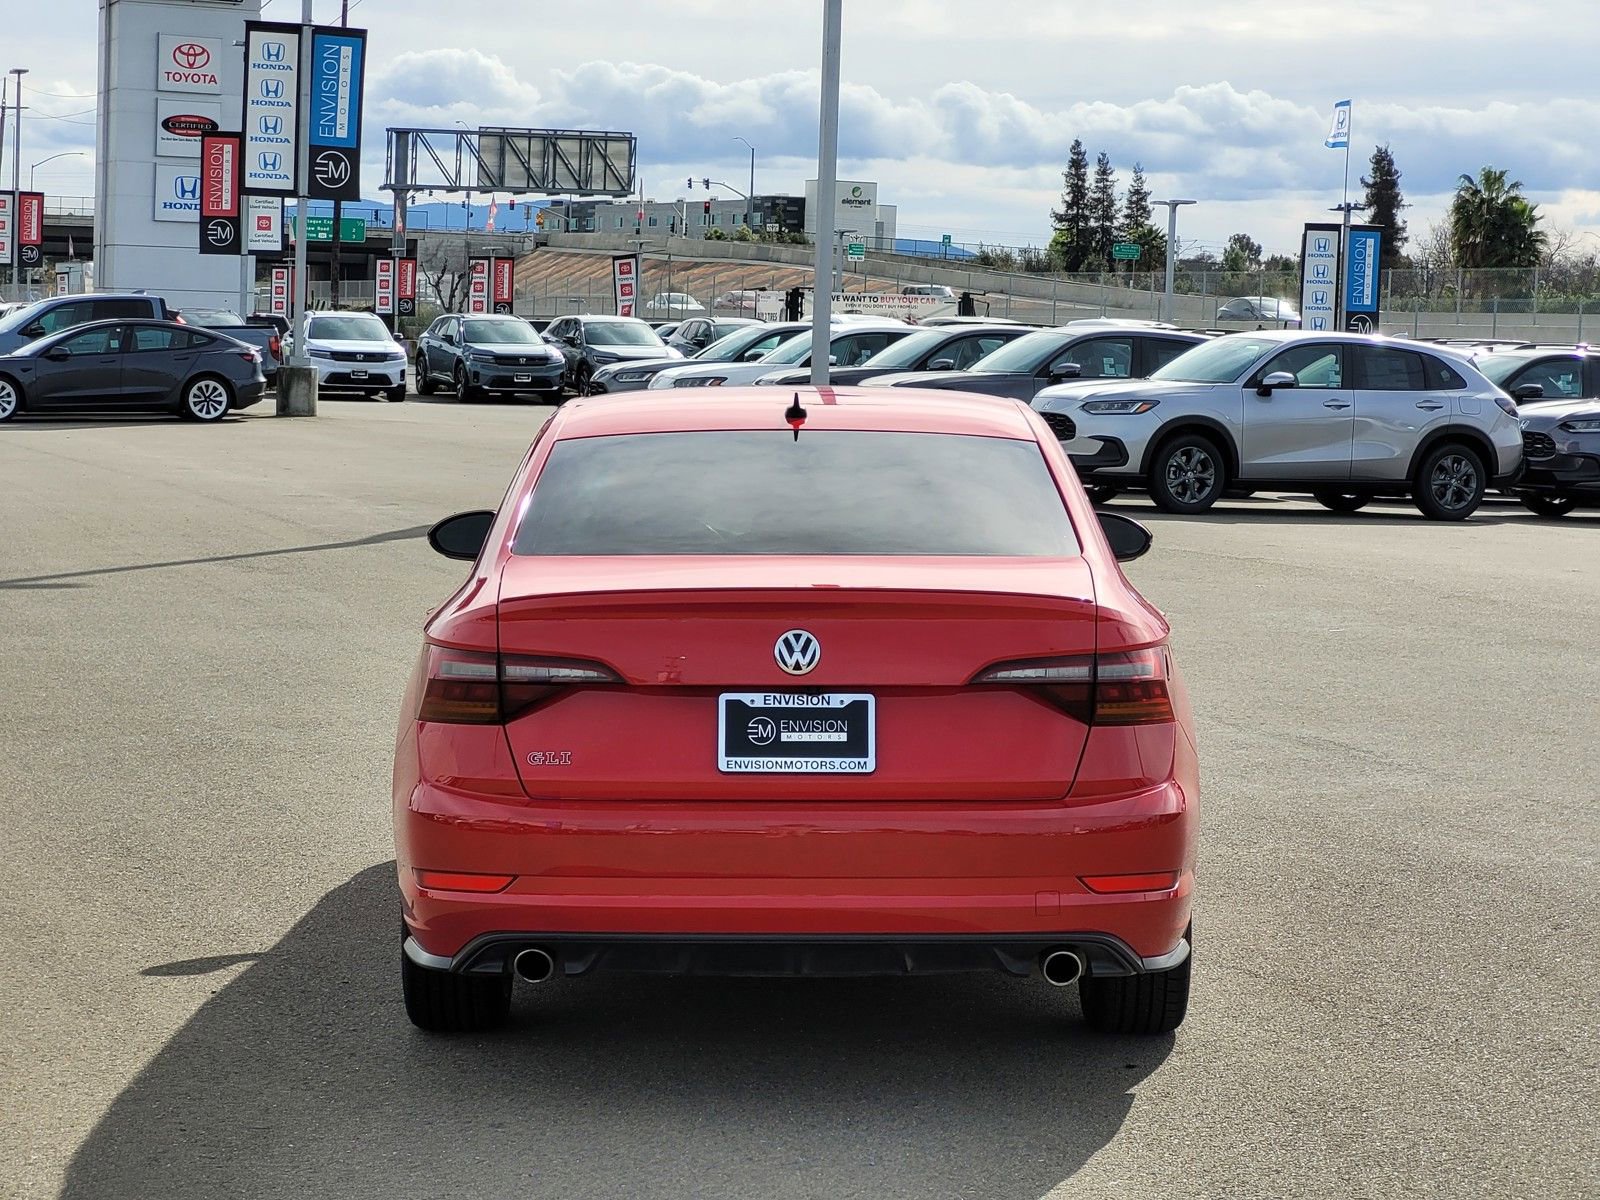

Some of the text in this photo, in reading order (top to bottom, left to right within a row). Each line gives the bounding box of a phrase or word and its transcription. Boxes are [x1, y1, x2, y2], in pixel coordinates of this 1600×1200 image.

[251, 62, 294, 71] HONDA
[164, 71, 218, 85] TOYOTA
[319, 44, 340, 138] ENVISION
[338, 54, 350, 131] MOTORS
[250, 99, 292, 108] HONDA
[249, 135, 291, 144] HONDA
[209, 143, 223, 210] ENVISION
[248, 172, 290, 180] HONDA
[162, 202, 200, 210] HOND
[841, 197, 872, 206] element
[23, 199, 32, 241] ENVISION
[1352, 237, 1366, 306] ENVISION
[496, 262, 504, 299] ENVISION
[880, 296, 897, 304] BUY
[920, 297, 936, 305] CAR
[763, 694, 831, 706] ENVISION
[780, 719, 848, 732] ENVISION
[527, 751, 571, 766] GLI
[726, 759, 868, 770] ENVISIONMOTORS.COM
